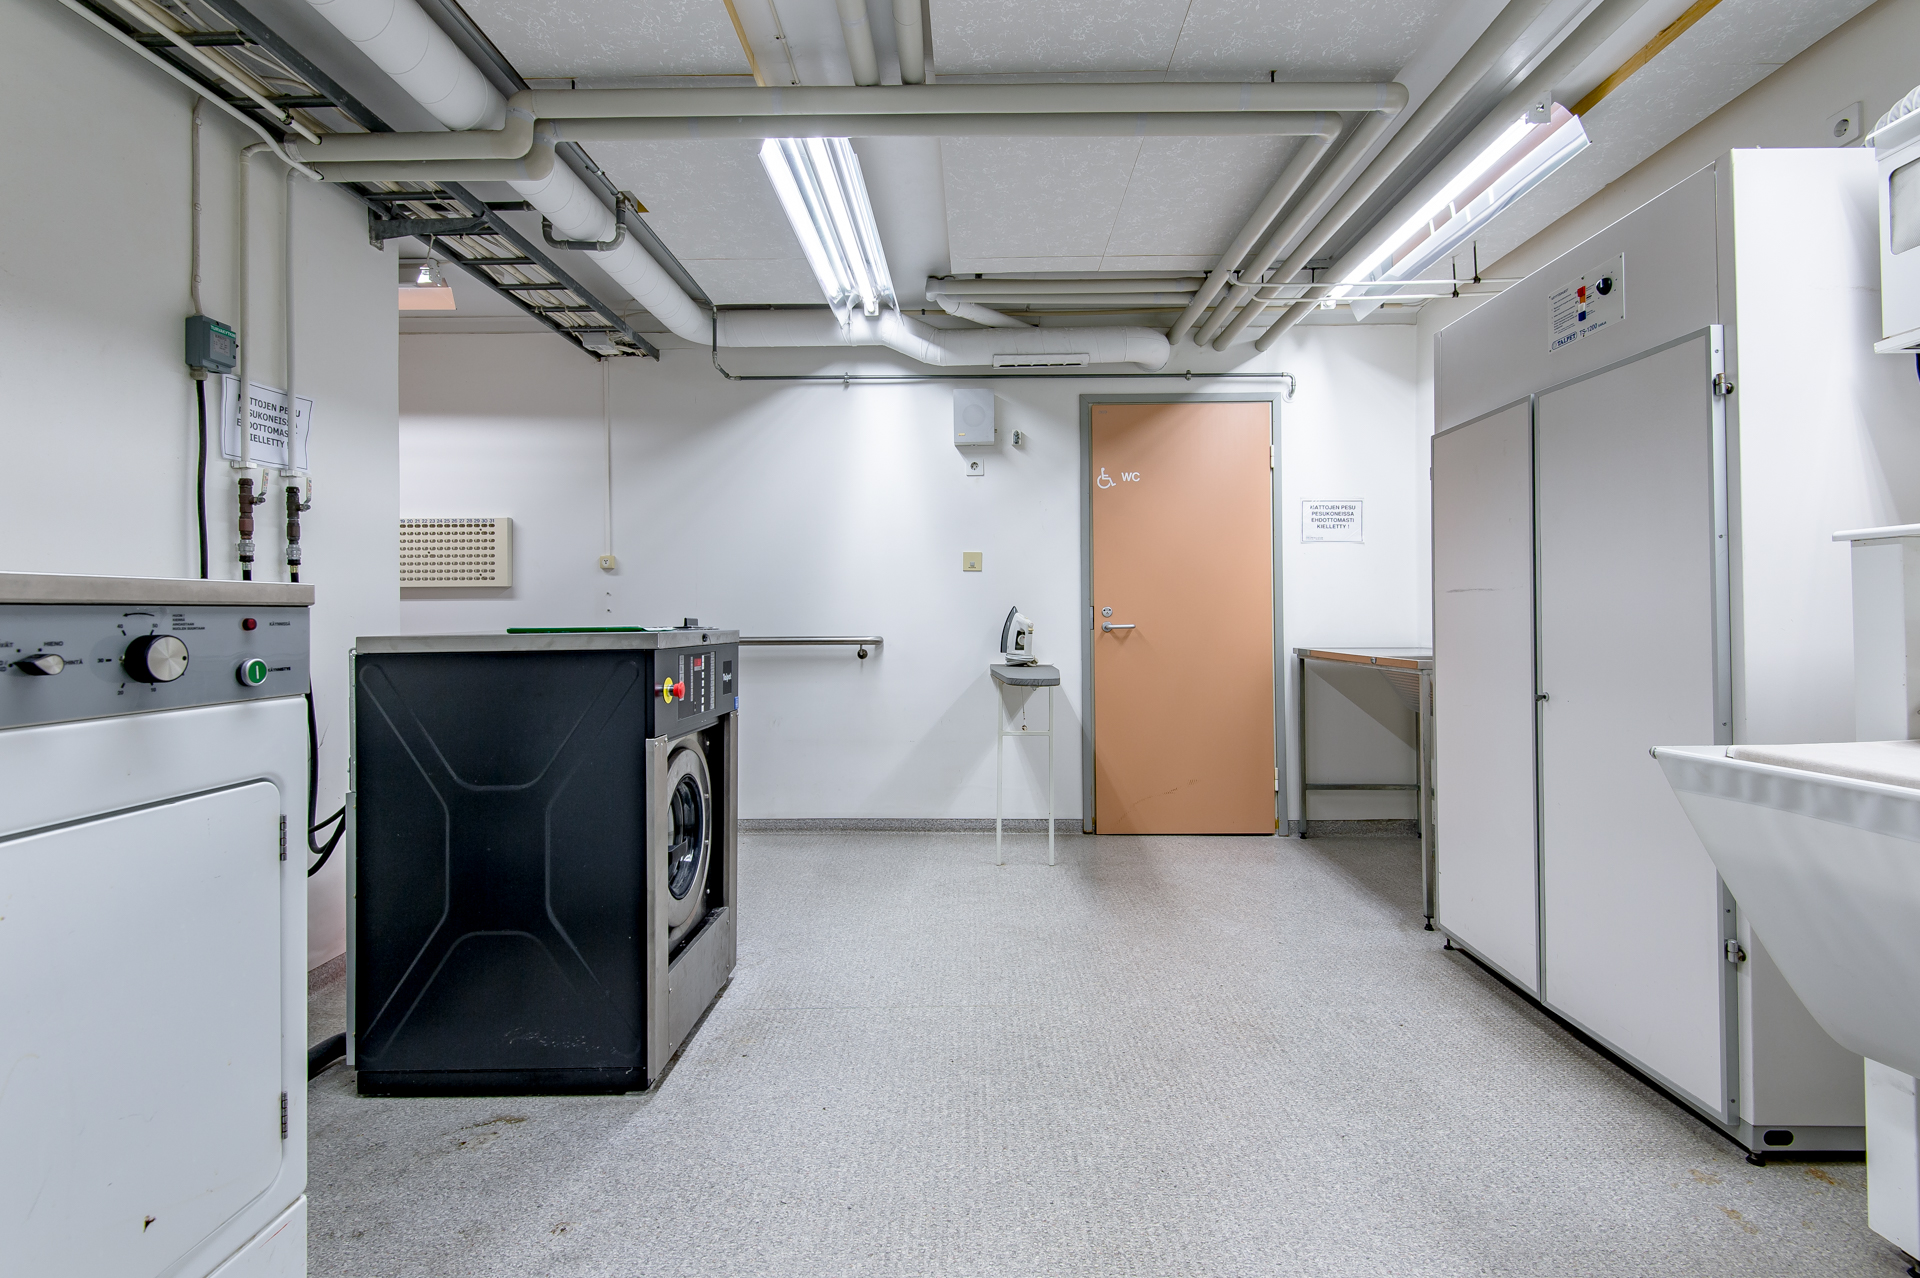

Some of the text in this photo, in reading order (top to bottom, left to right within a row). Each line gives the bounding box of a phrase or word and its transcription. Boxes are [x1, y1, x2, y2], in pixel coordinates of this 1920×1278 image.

[1558, 333, 1576, 346] TALPET
[238, 394, 300, 418] TTOJEN PEU
[250, 434, 285, 448] IELLETTY
[1121, 472, 1140, 482] WC
